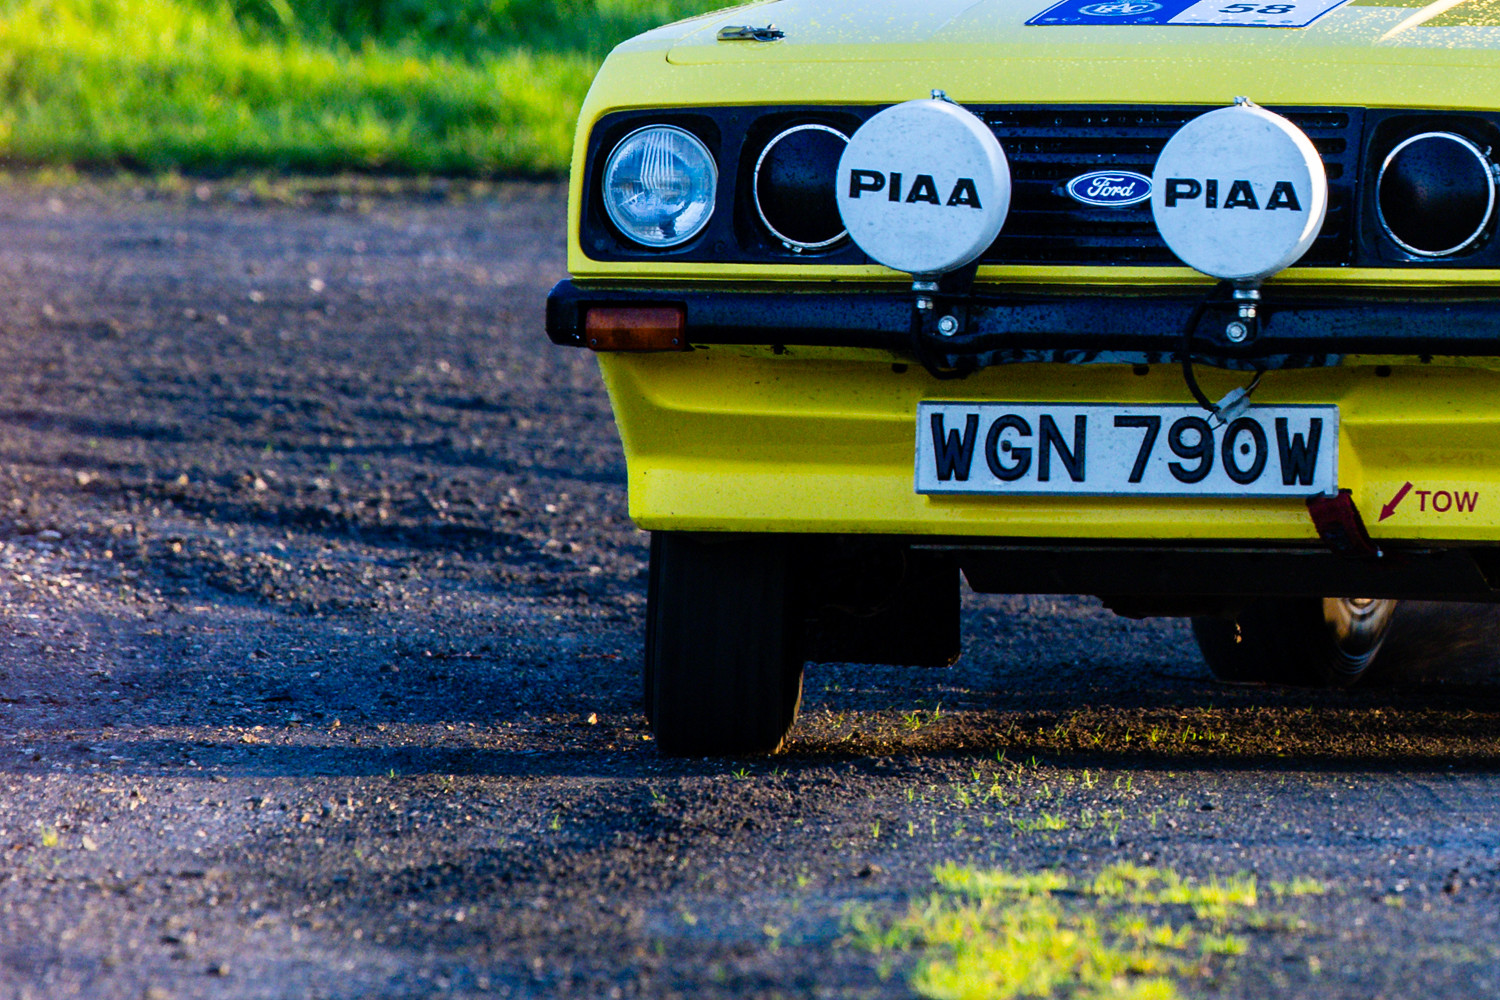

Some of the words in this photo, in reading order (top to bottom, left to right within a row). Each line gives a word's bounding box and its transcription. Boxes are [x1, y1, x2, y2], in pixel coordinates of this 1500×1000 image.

[1217, 3, 1297, 15] 58
[848, 168, 983, 209] PIAA
[1086, 175, 1135, 199] Ford
[1165, 178, 1303, 211] PIAA
[930, 413, 1088, 482] WGN
[1113, 415, 1324, 486] 790W
[1415, 489, 1479, 513] TOW
